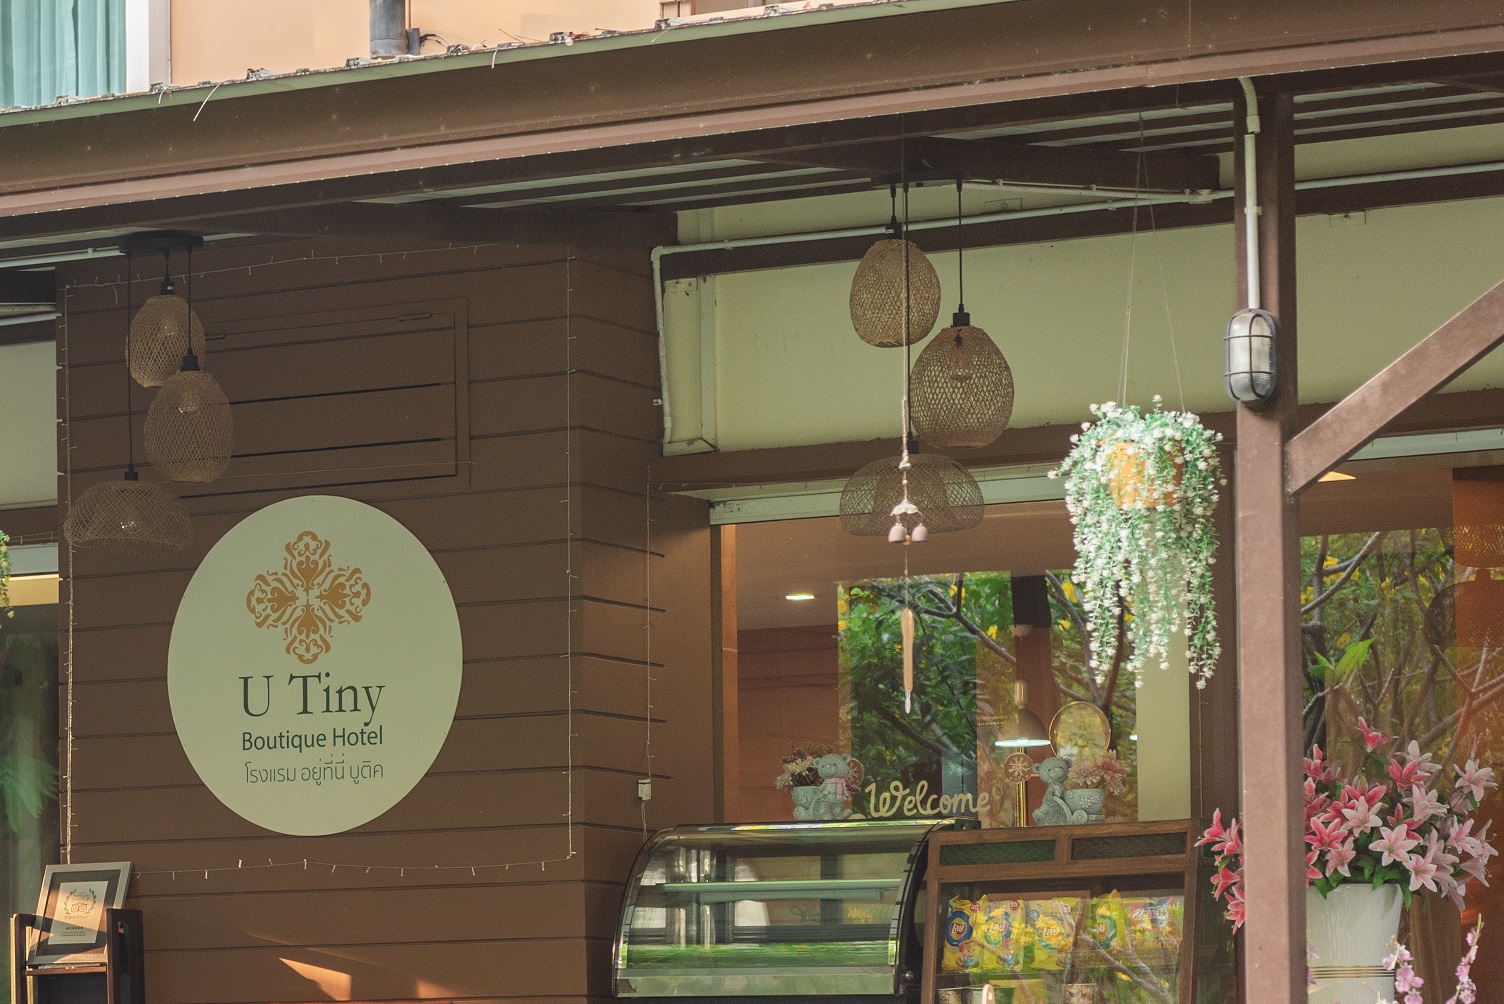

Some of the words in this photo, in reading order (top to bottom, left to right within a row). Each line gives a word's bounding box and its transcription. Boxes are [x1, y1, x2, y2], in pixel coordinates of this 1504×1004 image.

[238, 674, 274, 717] U
[287, 671, 386, 728] Tiny
[242, 729, 327, 753] Boutique
[332, 725, 383, 748] Hotel
[244, 761, 296, 784] โรงแรม
[300, 753, 345, 786] อยู่ที่นี่
[349, 760, 384, 785] บูติค
[864, 780, 991, 818] Welcome
